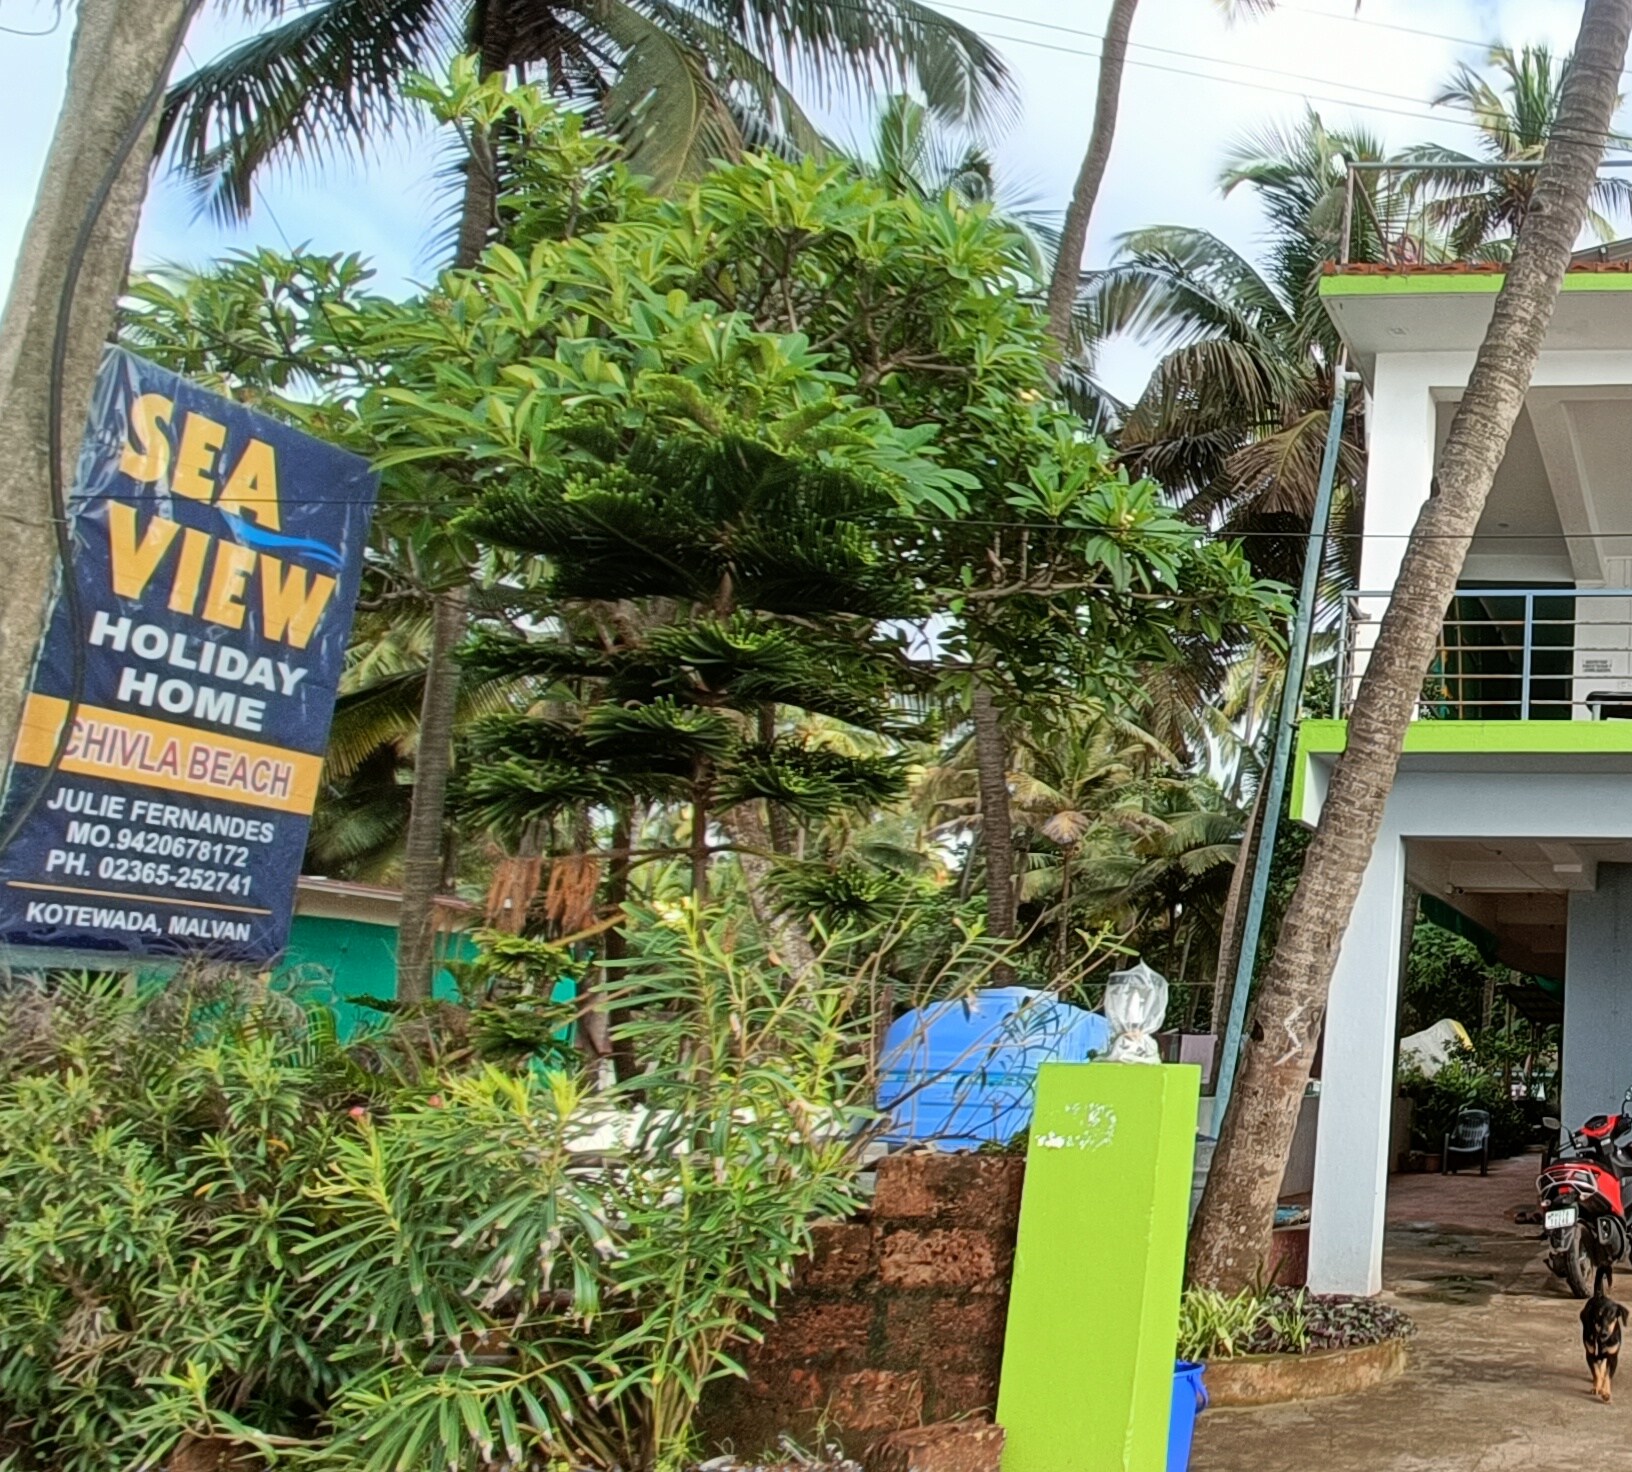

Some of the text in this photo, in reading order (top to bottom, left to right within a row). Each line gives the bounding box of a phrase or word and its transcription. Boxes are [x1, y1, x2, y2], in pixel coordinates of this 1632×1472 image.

[119, 393, 279, 531] SEA
[108, 500, 336, 651] VIEW
[89, 611, 308, 698] HOLIDAY
[117, 668, 267, 732] HOME
[63, 717, 292, 799] CHIVLA BEACH
[47, 787, 275, 844] JULIE FERNANDES
[66, 820, 249, 868] MO.9420678172
[45, 849, 251, 897] PH. 02365-252741
[26, 902, 250, 942] KOTEWADA, MALVAN
